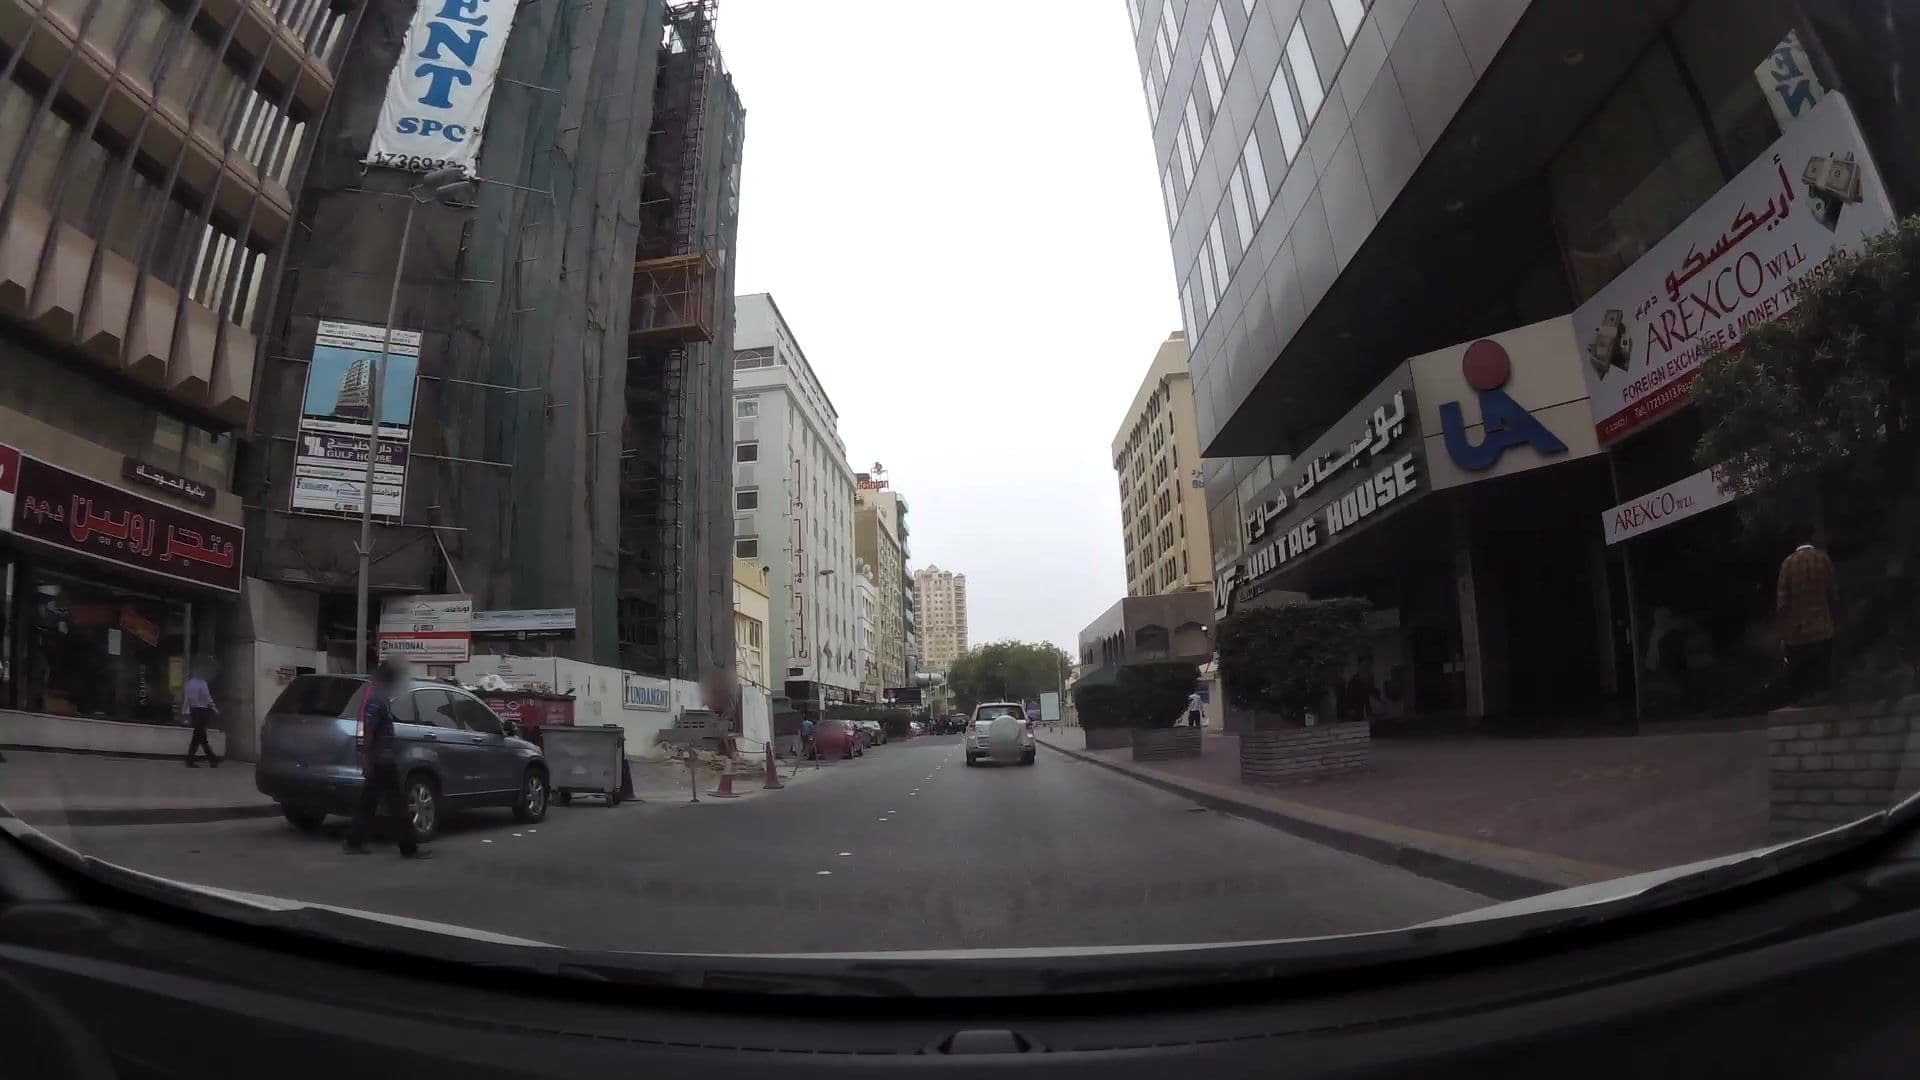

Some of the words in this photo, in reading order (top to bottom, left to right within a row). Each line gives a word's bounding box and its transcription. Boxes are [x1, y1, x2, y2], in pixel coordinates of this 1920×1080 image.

[396, 116, 467, 143] SPC
[1645, 251, 1765, 366] AREXCO
[1622, 367, 1667, 403] FOREIGN
[1666, 331, 1727, 376] EXCHAGE
[1727, 324, 1738, 340] &
[1737, 296, 1781, 336] MONEY
[326, 449, 354, 459] GULF
[69, 494, 156, 556] روبين
[1248, 517, 1318, 580] UNITAG
[1325, 452, 1417, 537] HOUSE
[1614, 492, 1675, 535] AREXCO
[159, 524, 234, 568] متجر
[388, 640, 425, 650] NATIONAL
